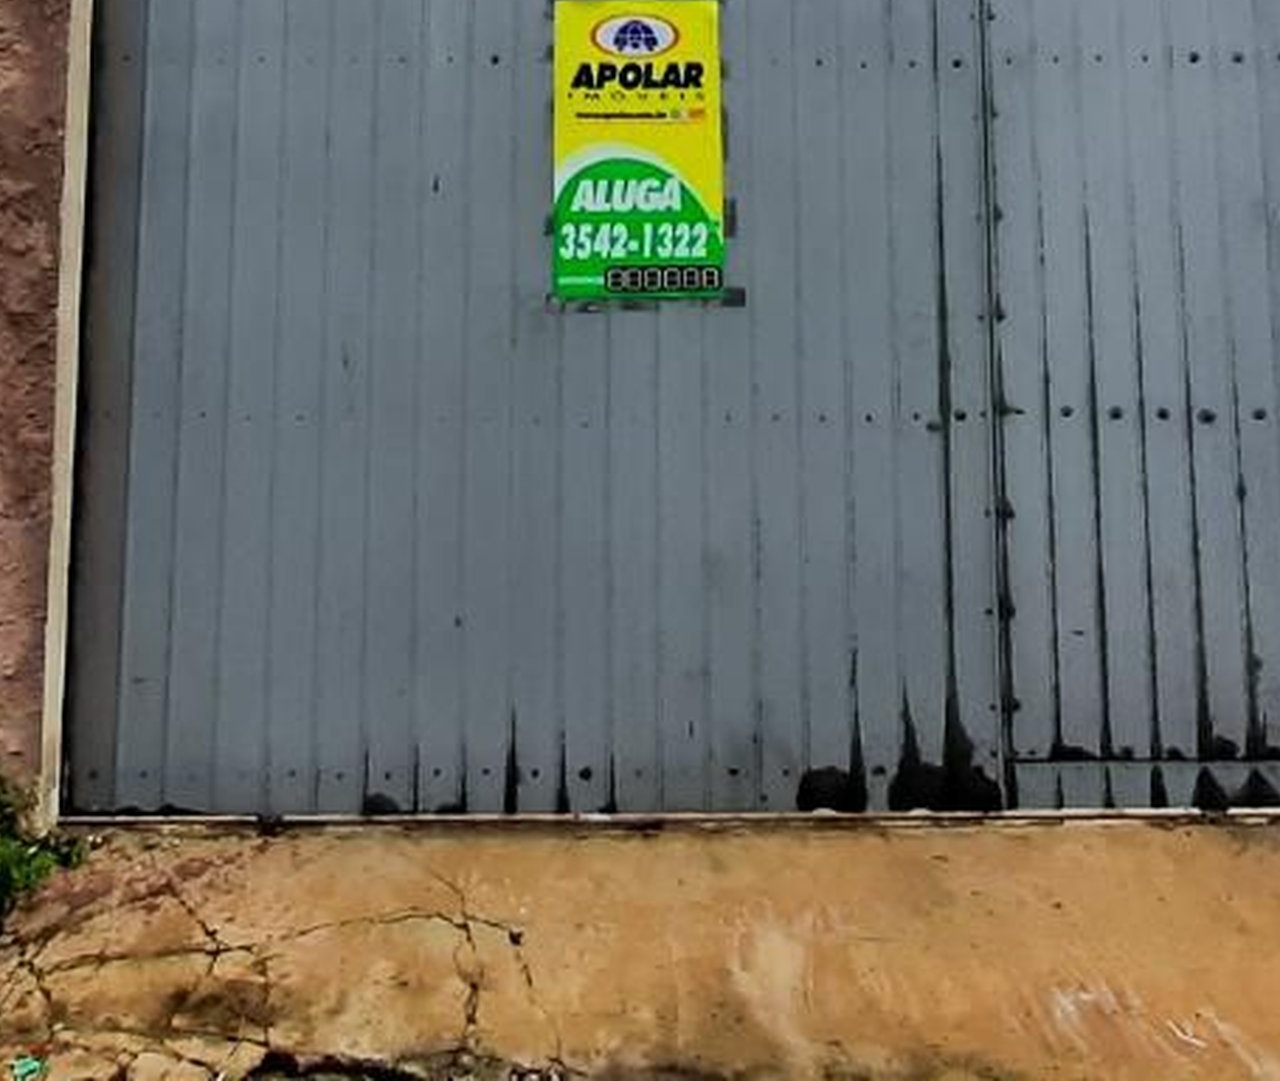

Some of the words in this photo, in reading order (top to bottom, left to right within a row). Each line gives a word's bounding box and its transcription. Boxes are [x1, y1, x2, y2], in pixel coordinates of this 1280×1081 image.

[571, 62, 704, 89] APOLAR
[572, 178, 682, 212] ALUGA
[559, 222, 708, 258] 3542-1322
